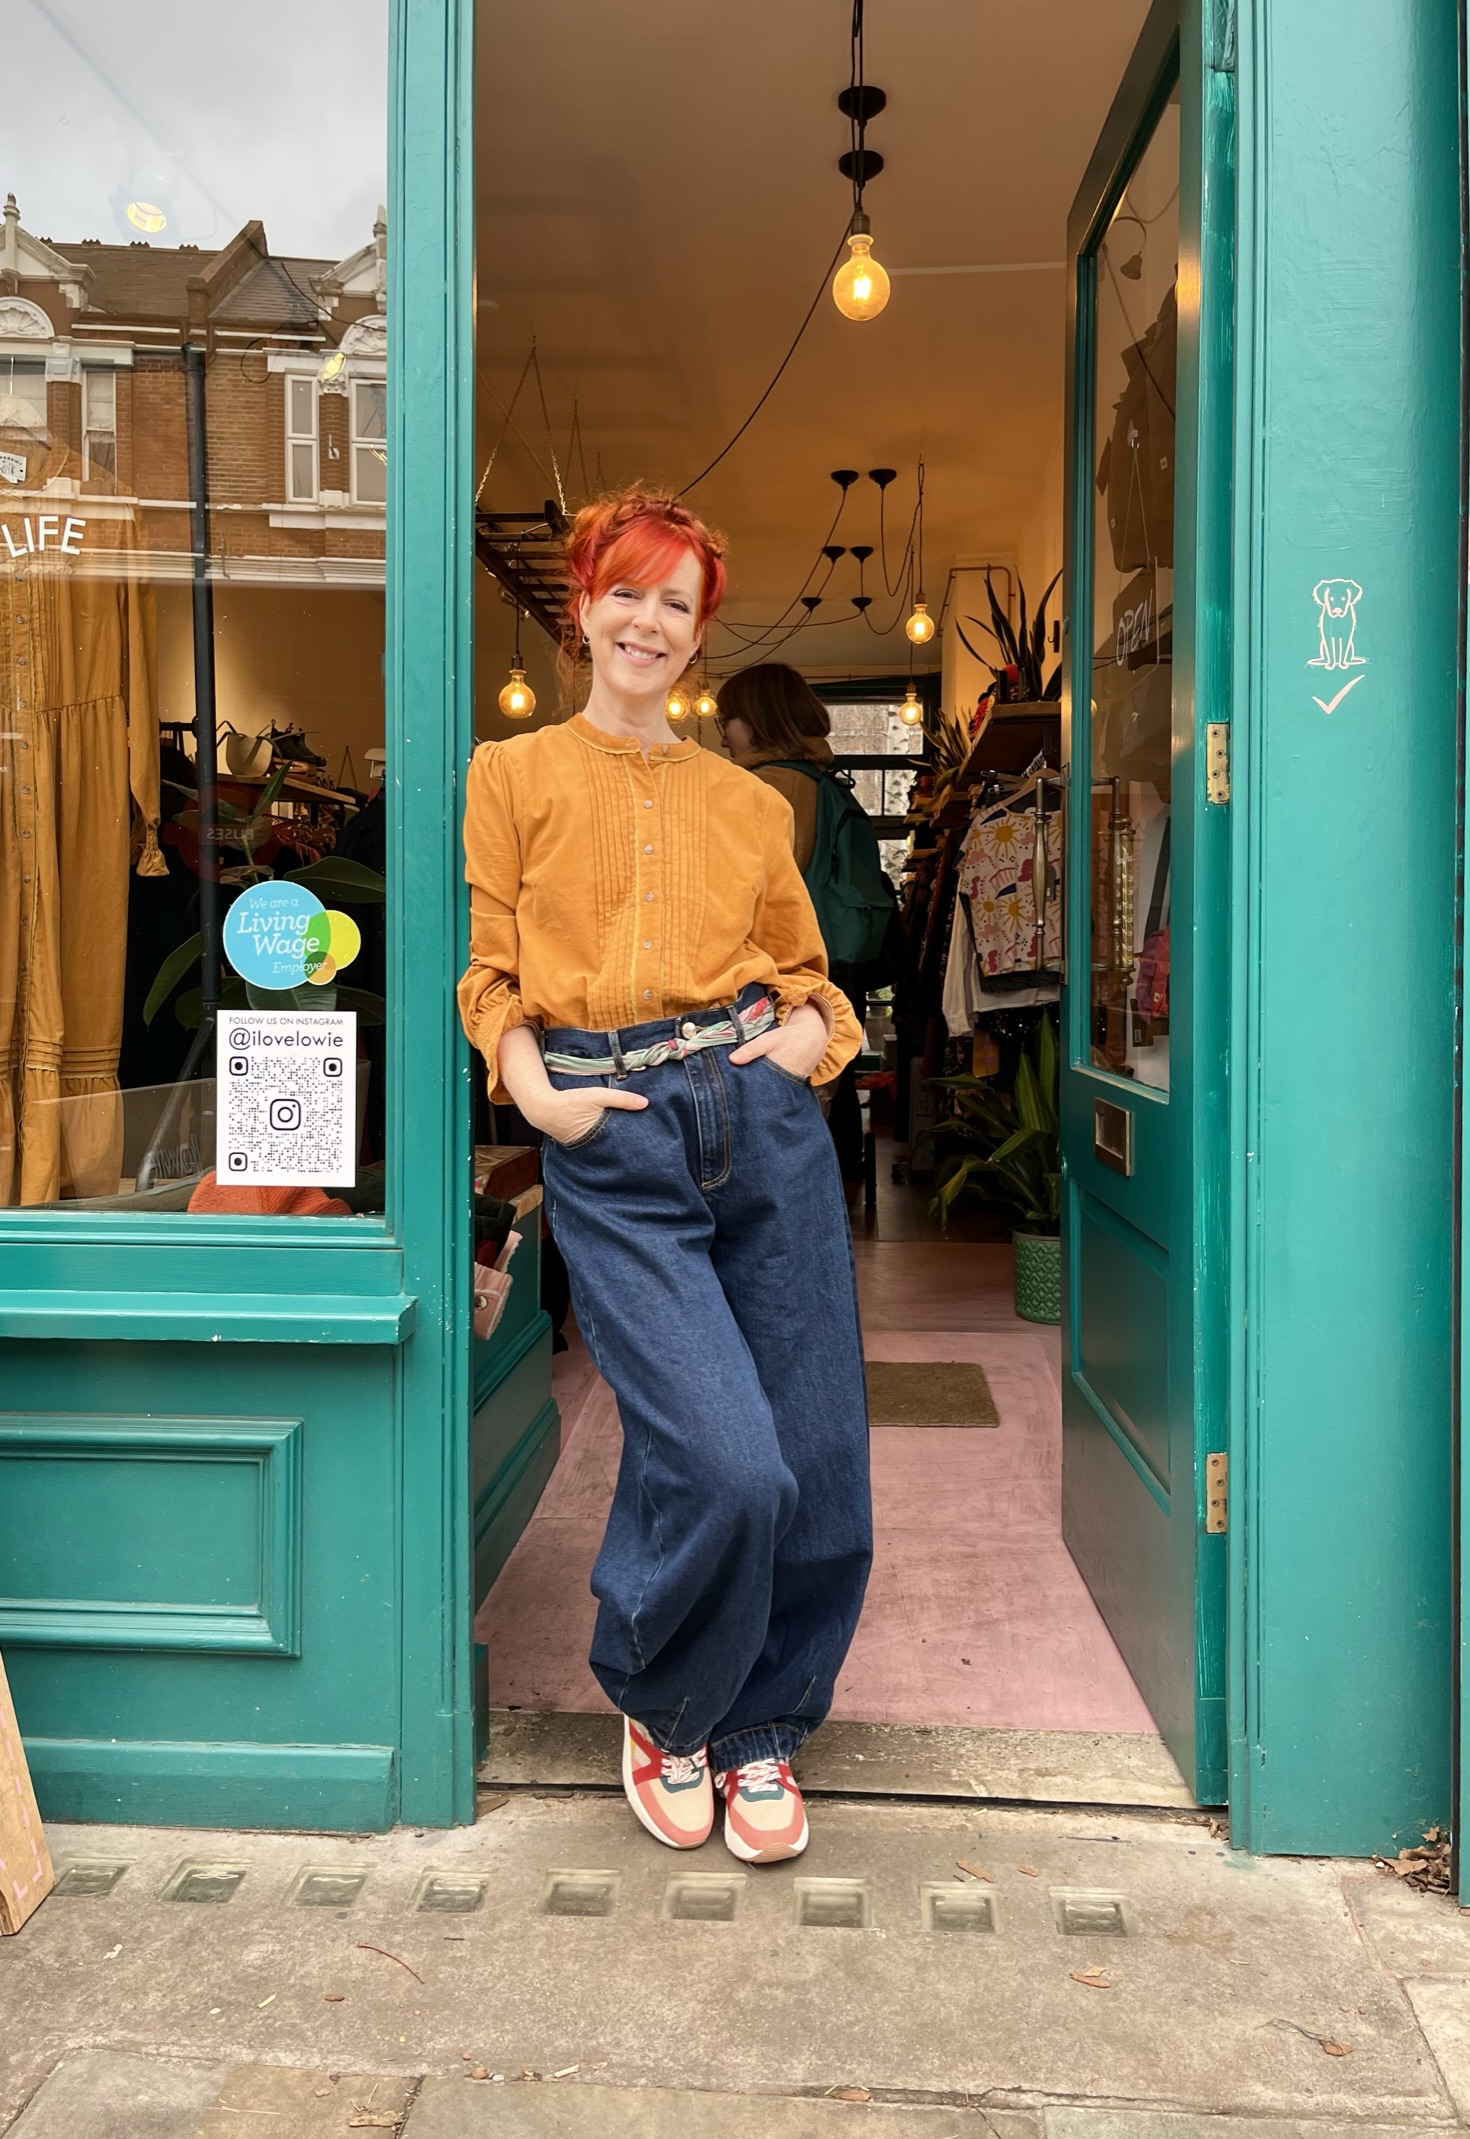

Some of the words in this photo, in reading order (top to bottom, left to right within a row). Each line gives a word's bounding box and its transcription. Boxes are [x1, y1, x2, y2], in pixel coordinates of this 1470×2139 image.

[1, 515, 87, 558] LIFE
[1116, 588, 1153, 666] OPEN
[250, 898, 268, 909] We
[269, 899, 289, 908] are
[291, 899, 299, 907] a
[237, 911, 311, 935] Living
[253, 933, 320, 959] Wage
[272, 962, 328, 975] Employer
[229, 1017, 264, 1025] FOLLOW
[266, 1017, 278, 1025] US
[279, 1017, 294, 1025] ON
[295, 1018, 344, 1026] INSTAGRAM
[229, 1028, 344, 1051] @ilovelowie
